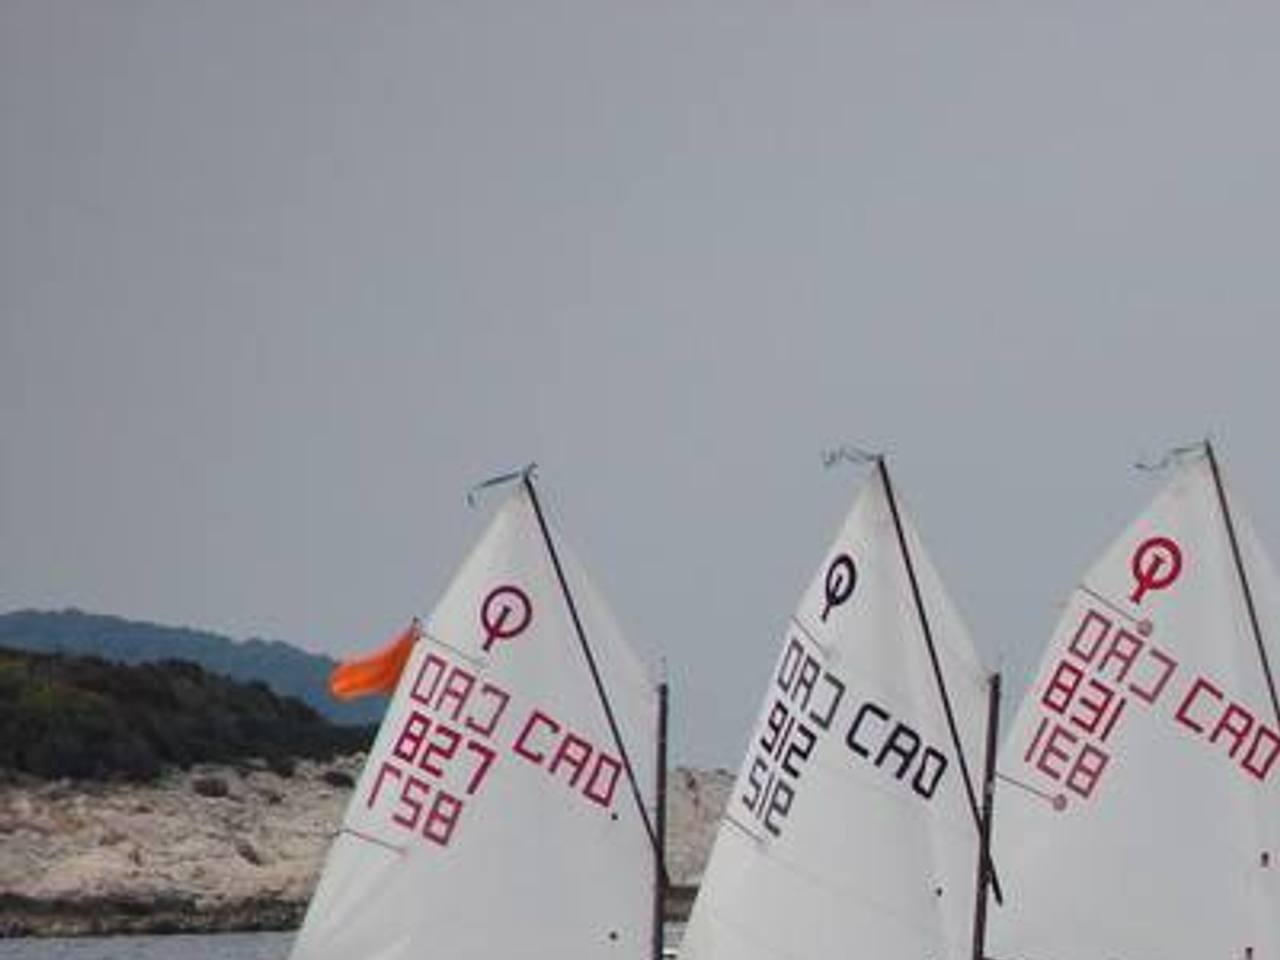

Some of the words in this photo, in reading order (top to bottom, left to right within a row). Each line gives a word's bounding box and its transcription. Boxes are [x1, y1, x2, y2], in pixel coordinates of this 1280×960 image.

[760, 701, 817, 779] 912
[1042, 659, 1127, 743] 831
[393, 710, 497, 795] 827
